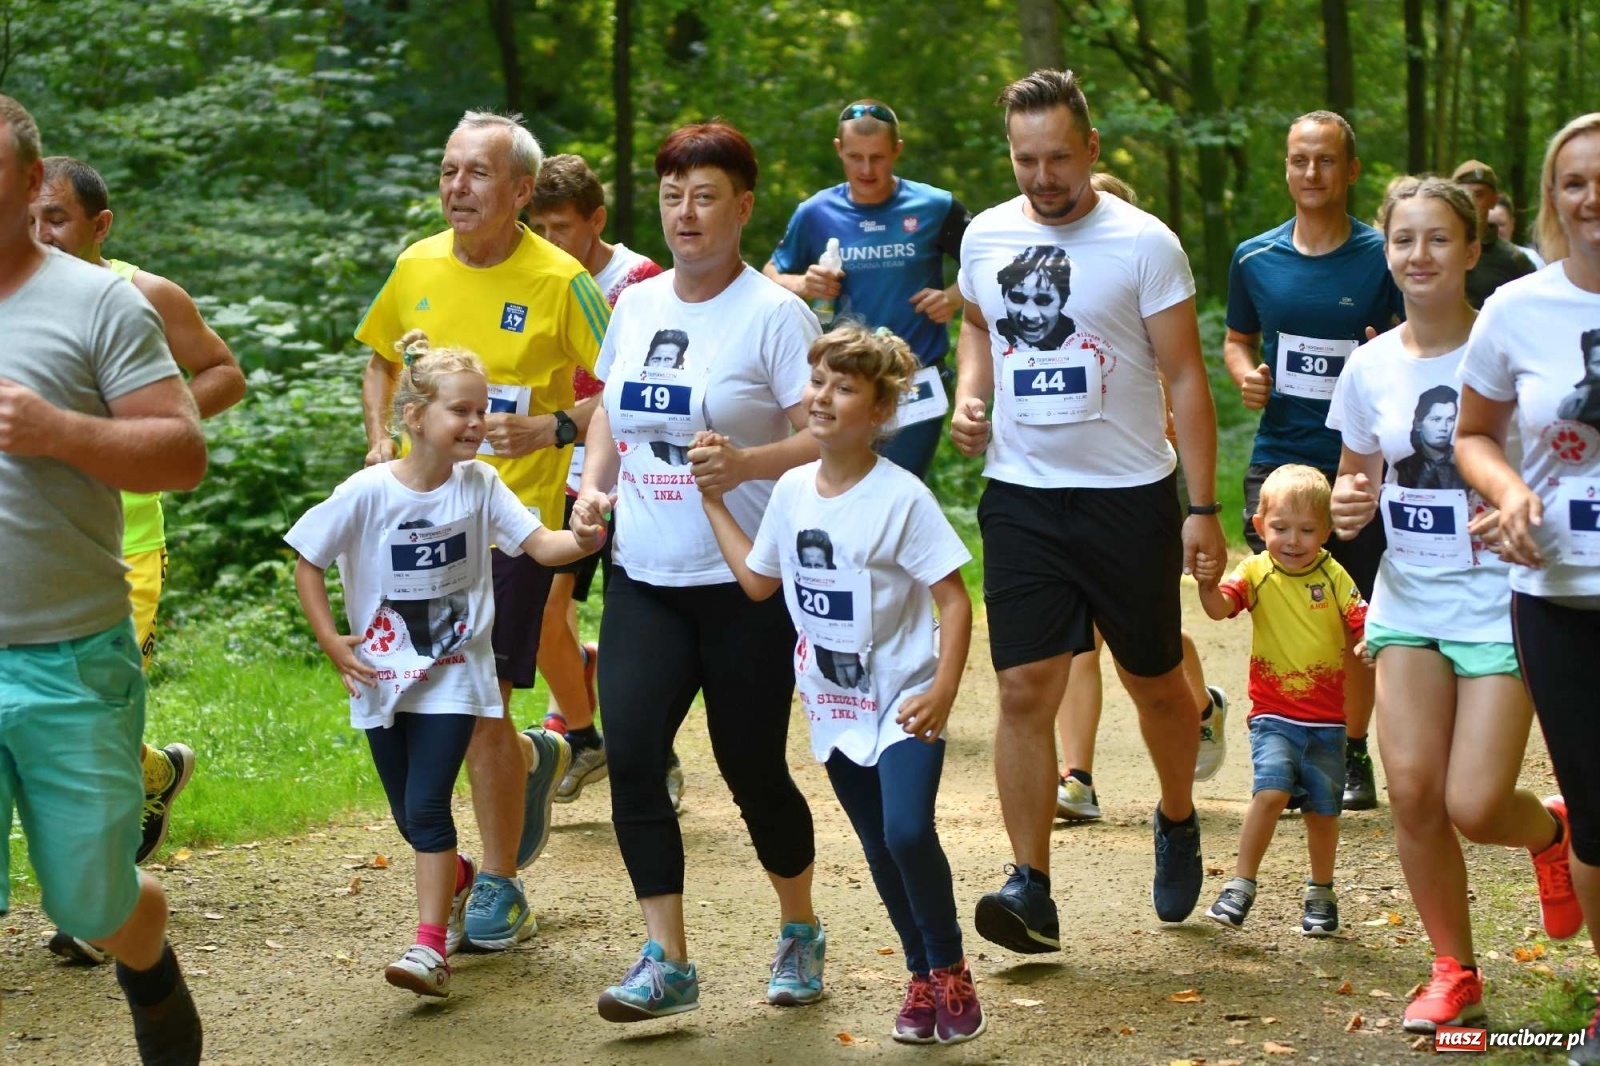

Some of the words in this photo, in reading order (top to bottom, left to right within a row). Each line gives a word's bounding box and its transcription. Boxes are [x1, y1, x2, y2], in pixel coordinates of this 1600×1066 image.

[840, 243, 915, 260] UNNERS
[1301, 356, 1328, 374] 30
[1032, 371, 1065, 392] 44
[641, 386, 670, 410] 19
[642, 474, 694, 484] SIEDZIK
[654, 490, 683, 500] INKA
[1403, 506, 1434, 530] 79
[415, 542, 447, 567] 21
[801, 589, 830, 615] 20
[831, 708, 857, 720] INKA
